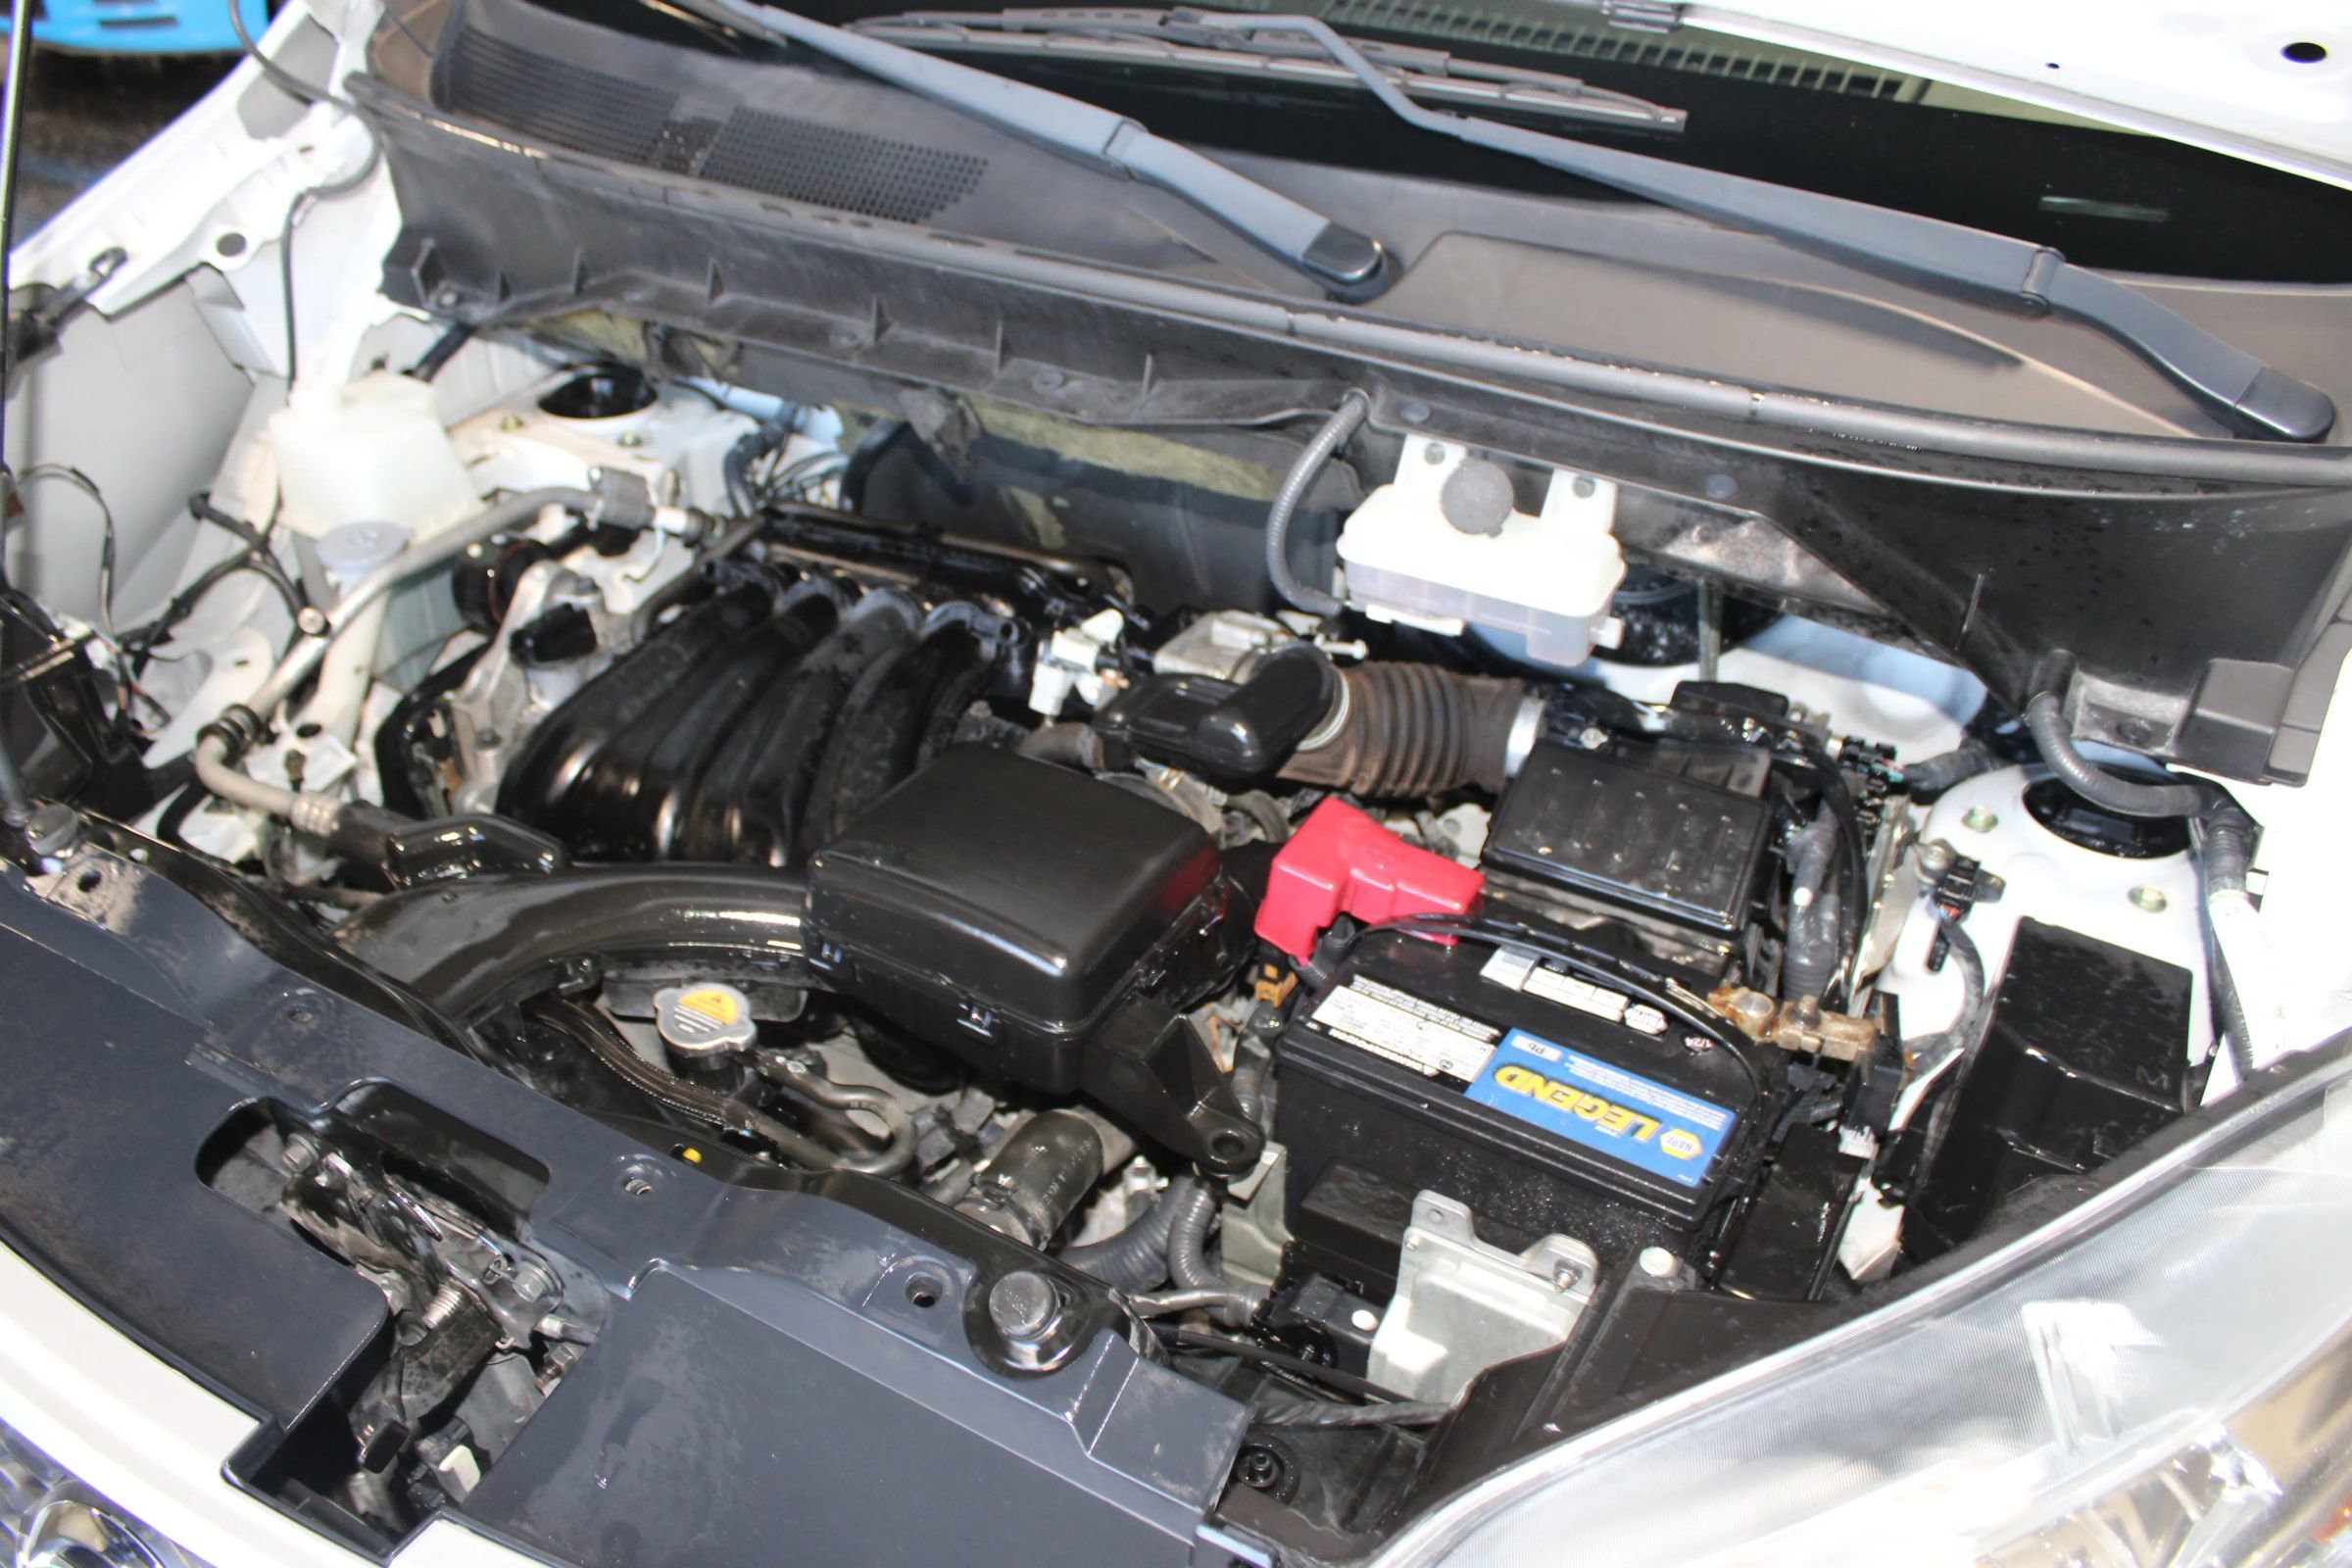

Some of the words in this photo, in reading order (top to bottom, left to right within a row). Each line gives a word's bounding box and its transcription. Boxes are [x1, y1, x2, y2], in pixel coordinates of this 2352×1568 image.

[1528, 1042, 1545, 1055] Pb
[1494, 1063, 1662, 1143] LEGEND
[1667, 1135, 1694, 1152] NAPA
